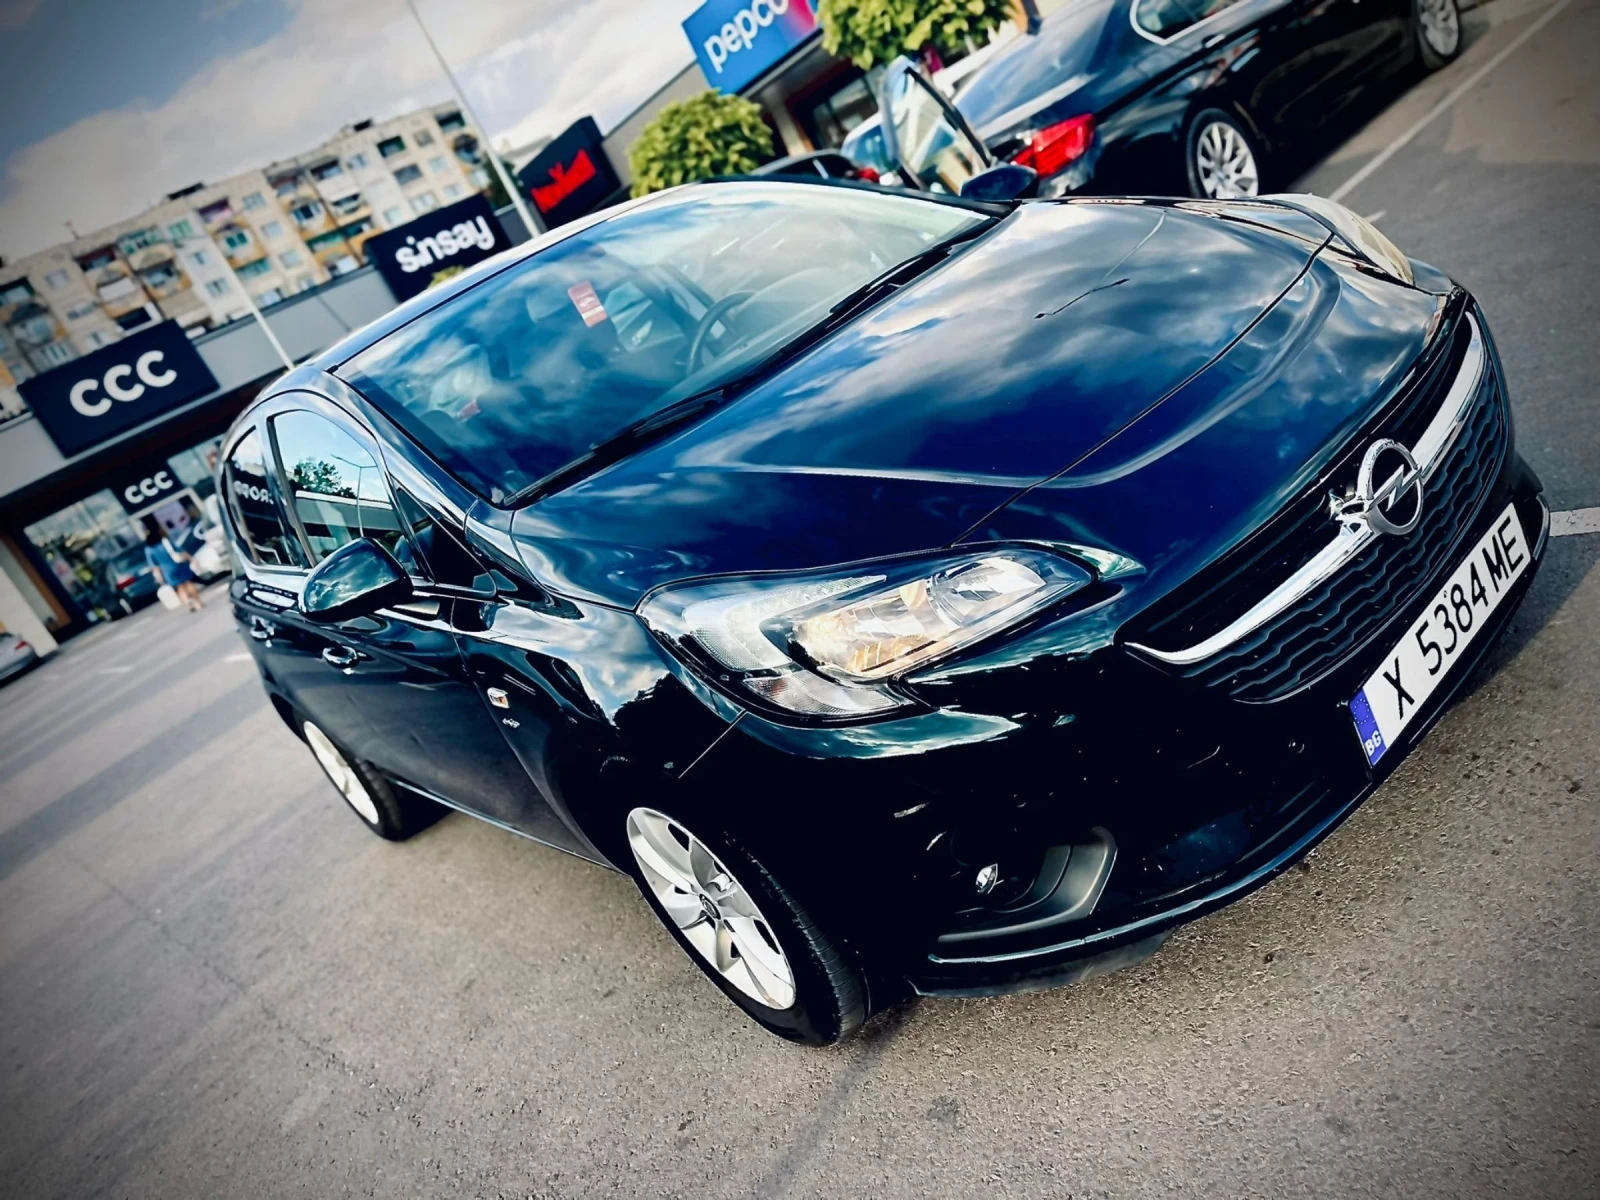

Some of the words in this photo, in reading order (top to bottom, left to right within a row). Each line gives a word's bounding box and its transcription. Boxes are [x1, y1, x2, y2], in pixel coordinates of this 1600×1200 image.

[395, 215, 496, 274] sinsay
[69, 350, 178, 417] CCC
[124, 471, 174, 504] CCC
[1382, 656, 1415, 720] X
[1415, 562, 1489, 676] 5384
[1481, 515, 1525, 593] ME
[1364, 729, 1383, 757] BG
